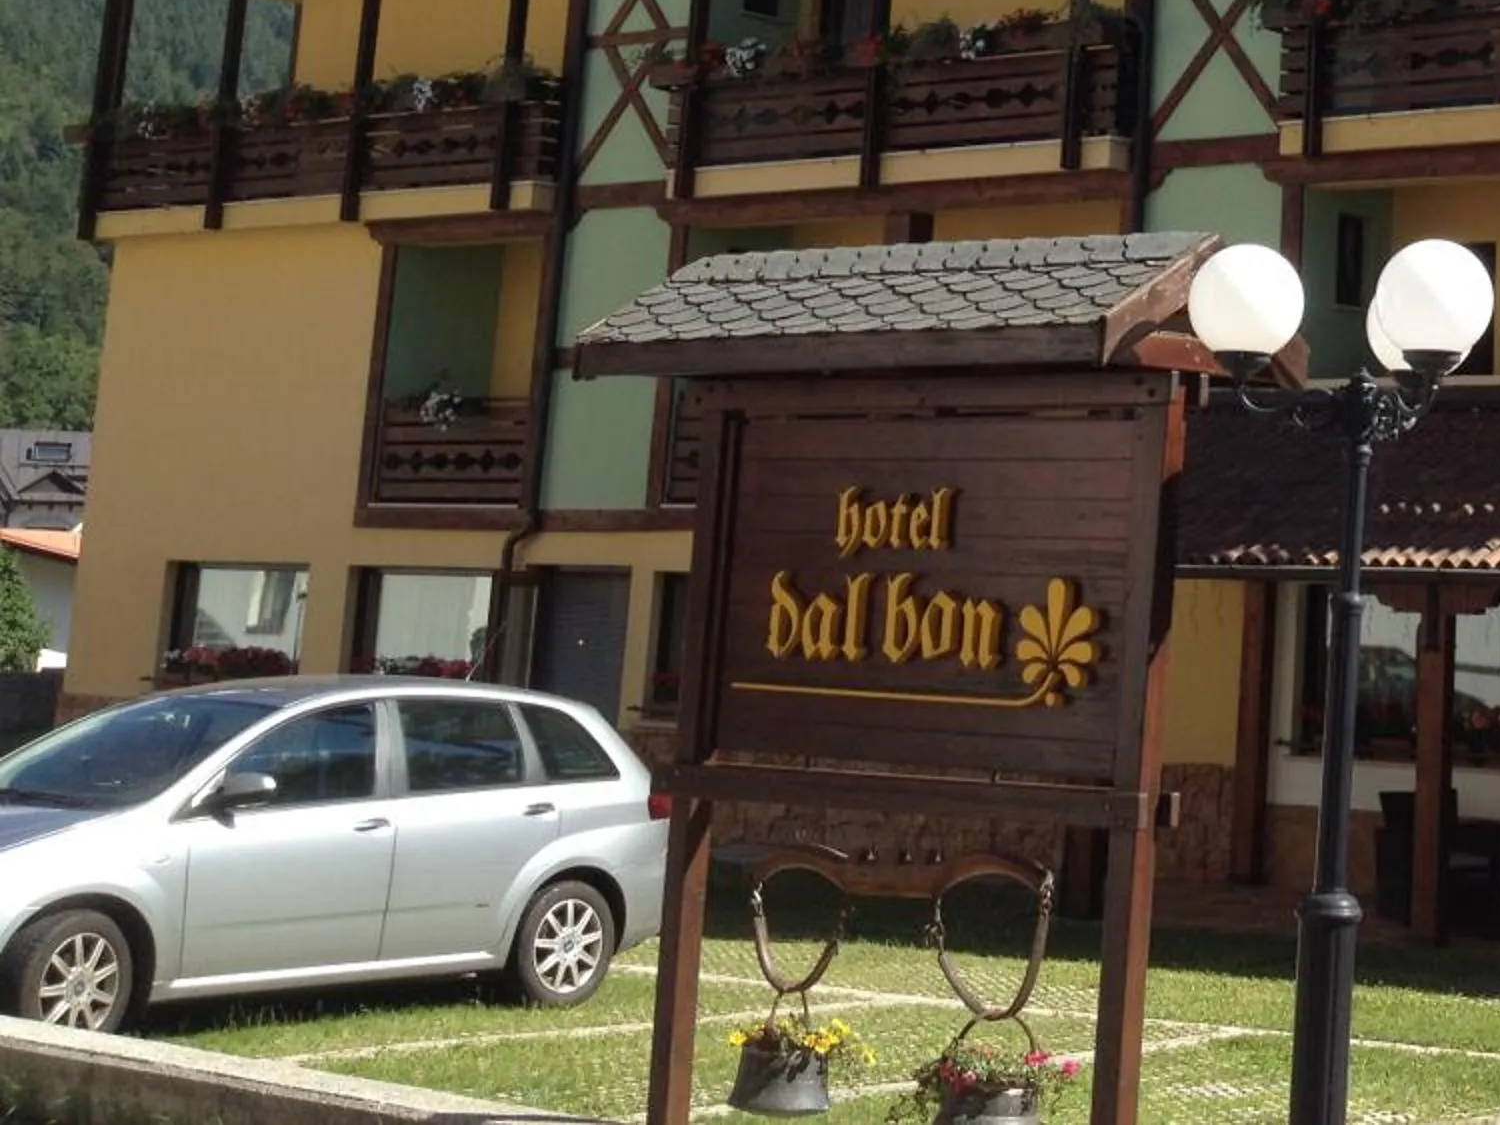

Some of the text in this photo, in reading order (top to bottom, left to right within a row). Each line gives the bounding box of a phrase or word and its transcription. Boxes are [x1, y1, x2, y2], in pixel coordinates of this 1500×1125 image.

[835, 485, 956, 557] hotel
[766, 570, 1001, 668] dal bon
